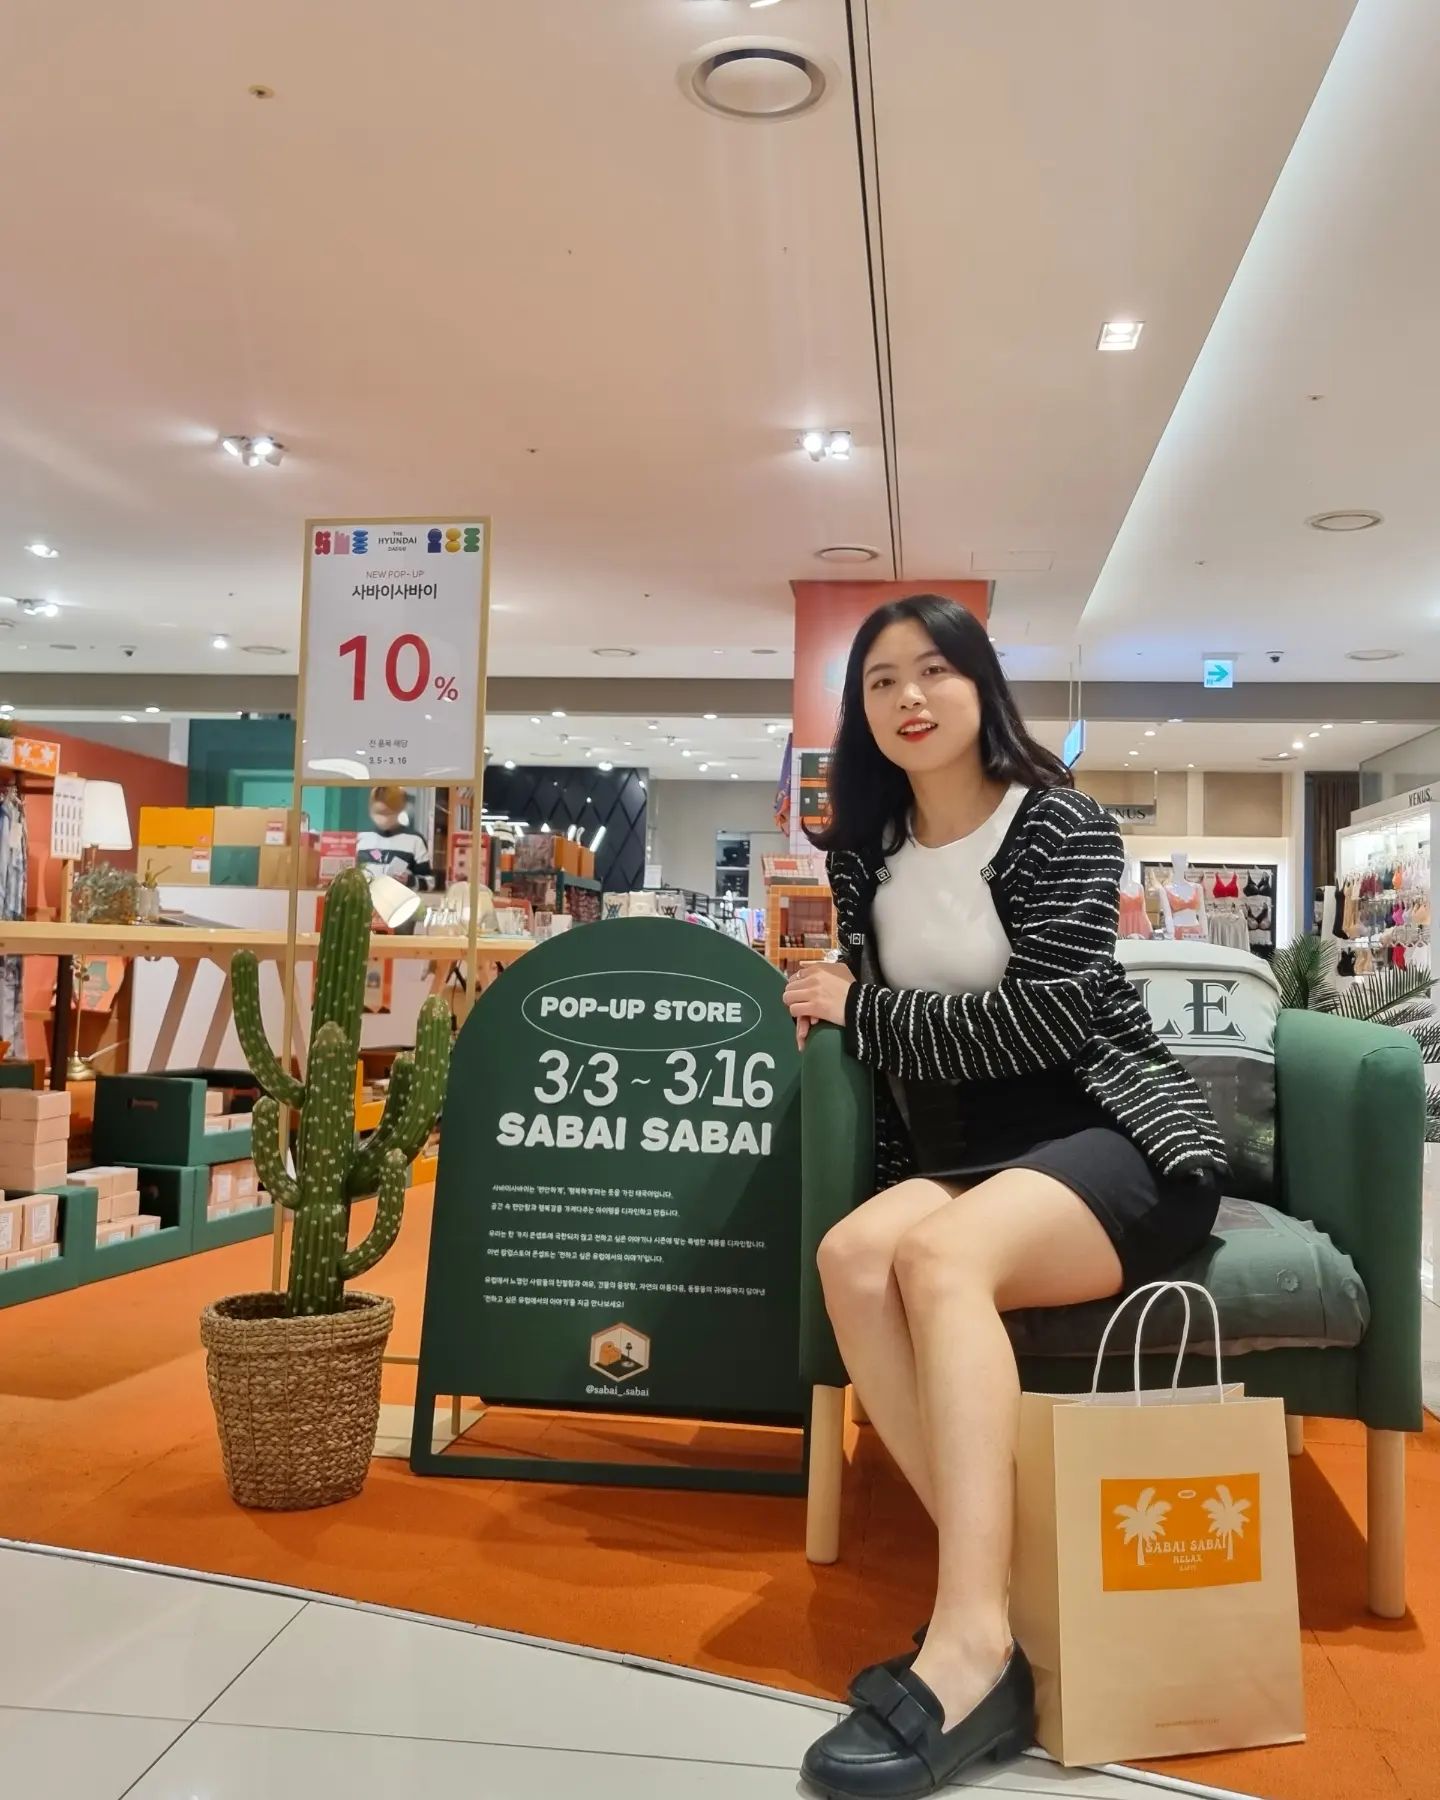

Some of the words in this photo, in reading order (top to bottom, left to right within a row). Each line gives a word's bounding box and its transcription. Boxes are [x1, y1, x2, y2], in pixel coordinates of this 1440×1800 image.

[366, 570, 387, 579] NEW
[352, 583, 438, 600] 사바이사바이
[339, 633, 459, 702] 10%
[540, 996, 646, 1020] POP-UP
[653, 1000, 743, 1023] STORE
[533, 1049, 620, 1107] 3/3
[663, 1049, 776, 1109] 3/16
[496, 1111, 627, 1151] SABAI
[640, 1117, 773, 1156] SABAI
[1145, 1539, 1186, 1553] SABAI
[1190, 1533, 1227, 1552] SABAI
[1173, 1554, 1203, 1564] RELAX
